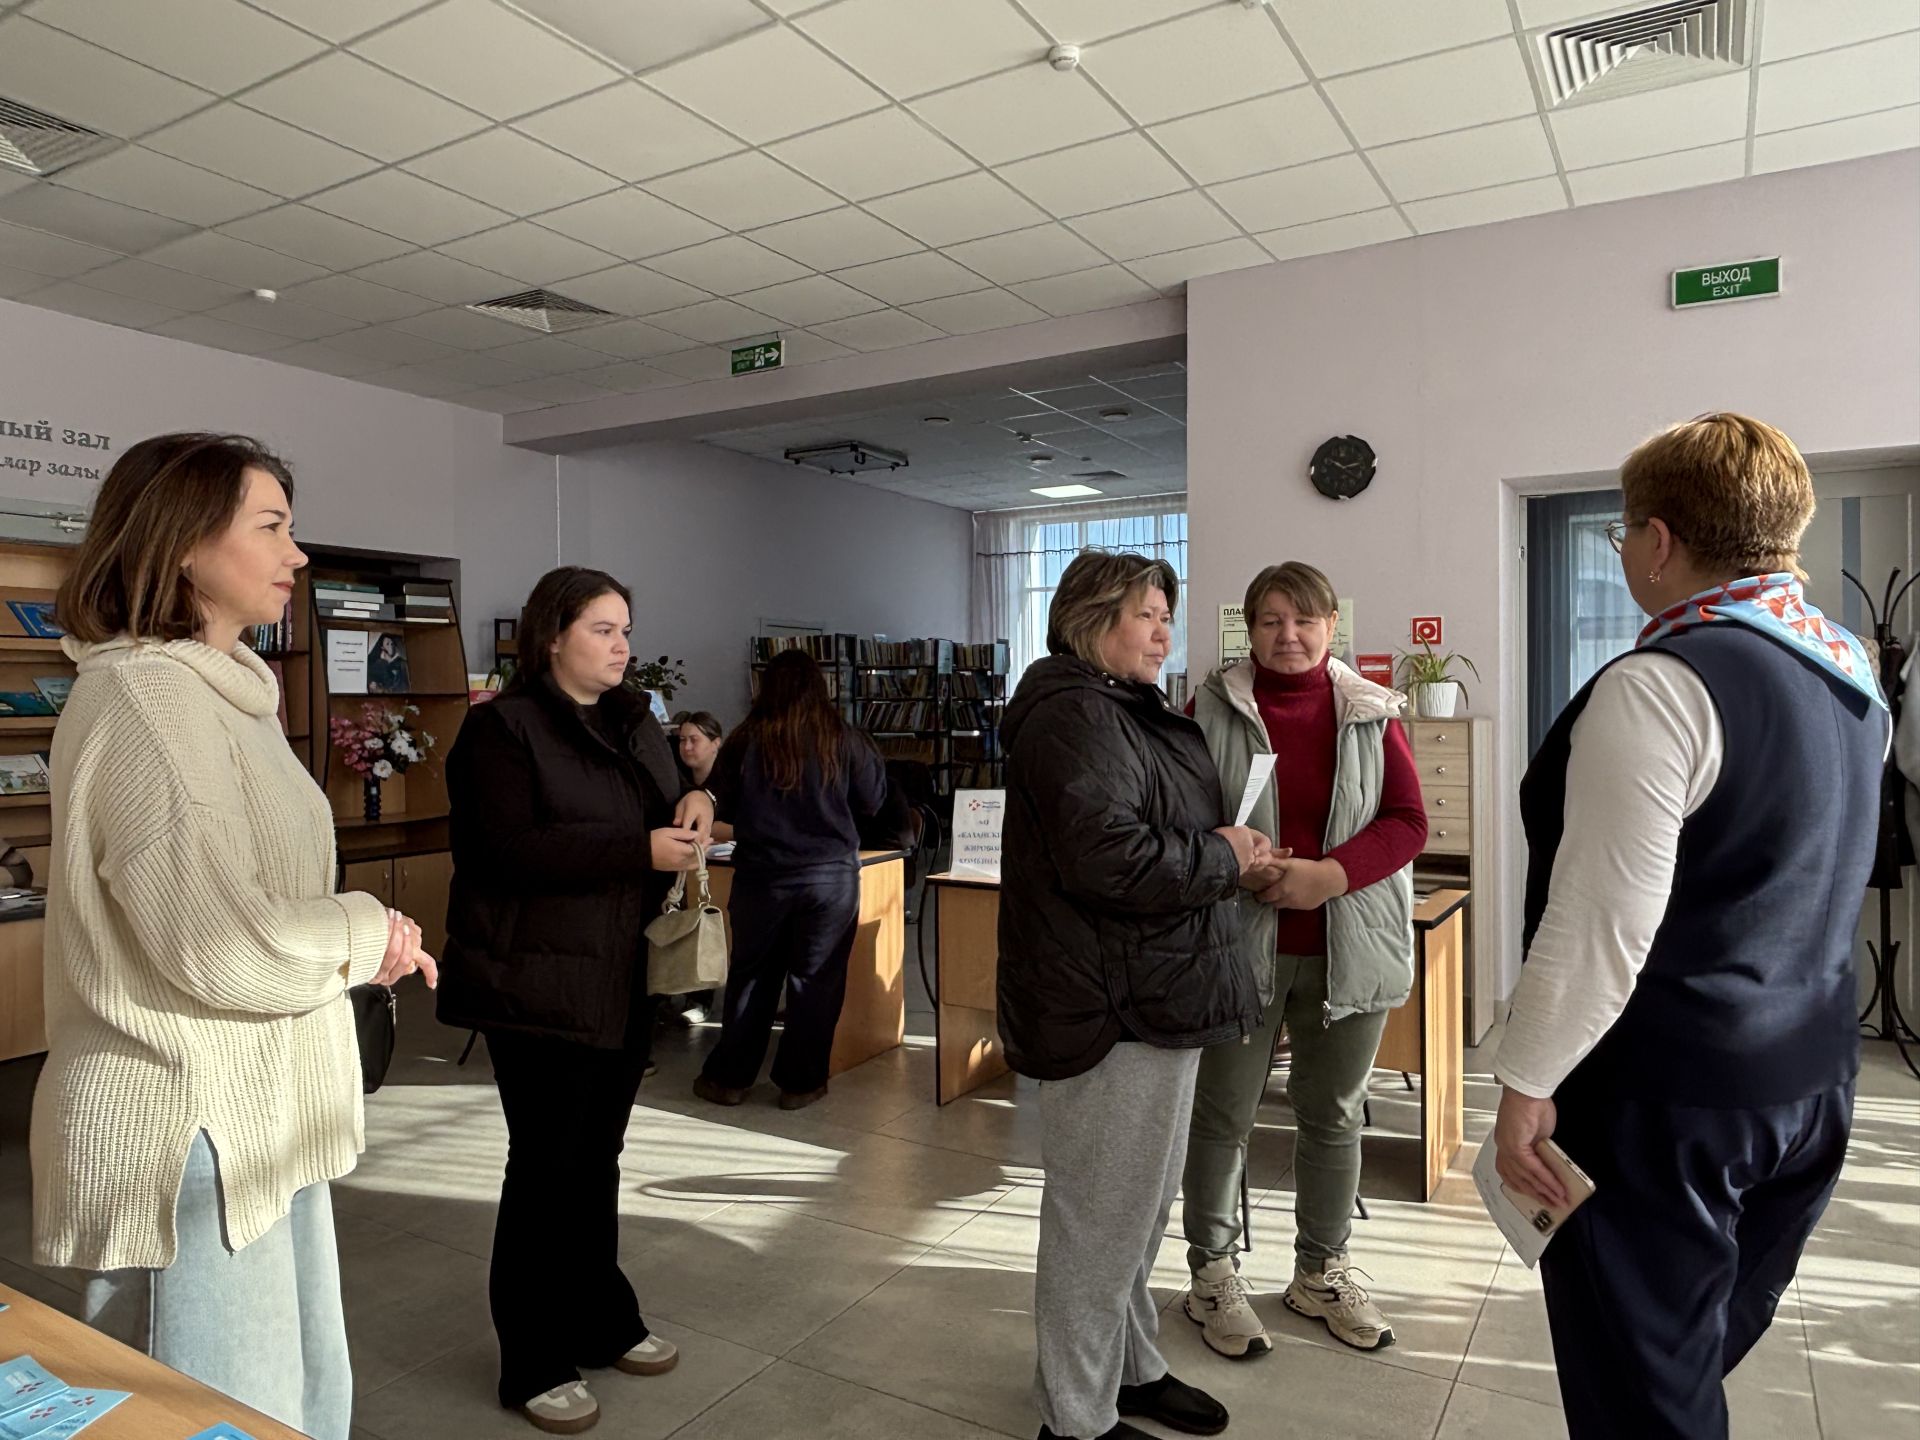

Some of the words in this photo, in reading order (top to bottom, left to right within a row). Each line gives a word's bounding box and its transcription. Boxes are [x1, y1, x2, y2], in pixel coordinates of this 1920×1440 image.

[1702, 267, 1751, 286] ВЫХОД
[1712, 283, 1741, 297] EXIT
[62, 429, 110, 450] зал
[47, 462, 100, 480] залы
